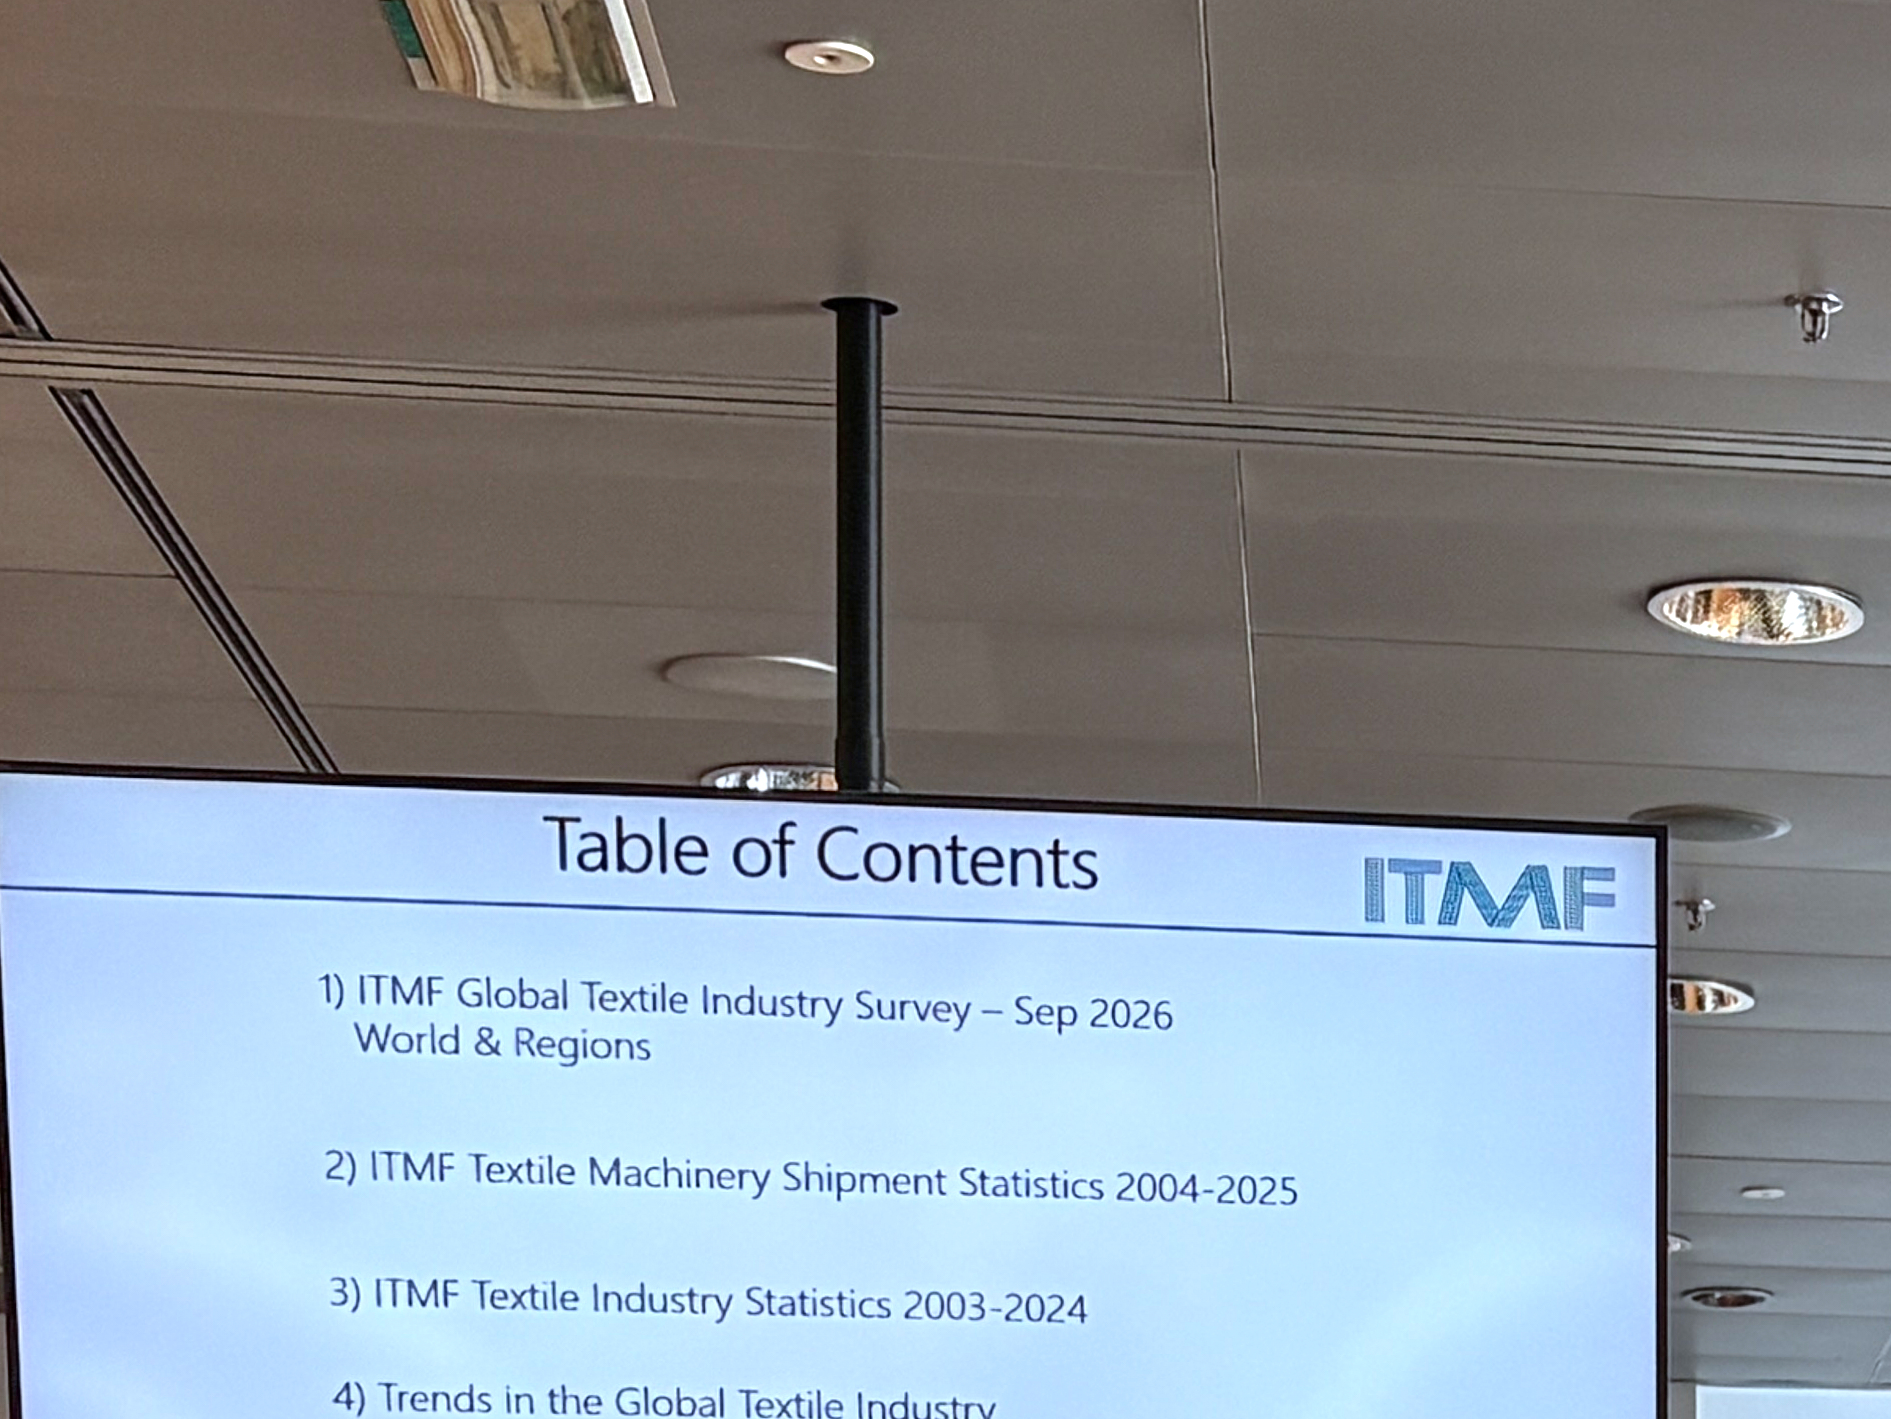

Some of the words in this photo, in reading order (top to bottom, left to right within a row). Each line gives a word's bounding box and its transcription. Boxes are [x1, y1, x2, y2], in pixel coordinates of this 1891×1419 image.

[542, 815, 709, 876] Table
[732, 820, 797, 879] of
[817, 825, 1099, 891] Contents
[1364, 857, 1616, 932] ITMF
[318, 973, 344, 1010] 1)
[359, 974, 444, 1007] ITMF
[457, 975, 568, 1011] Global
[580, 980, 689, 1014] Textile
[702, 984, 844, 1028] Industry
[855, 990, 972, 1032] Survey
[1014, 995, 1078, 1036] Sep
[1089, 998, 1173, 1031] 2026
[353, 1021, 460, 1055] World
[474, 1026, 502, 1057] &
[515, 1026, 651, 1068] Regions
[325, 1149, 357, 1187] 2)
[371, 1150, 455, 1183] ITMF
[468, 1153, 576, 1186] Textile
[589, 1156, 771, 1200] Machinery
[783, 1160, 947, 1202] Shipment
[959, 1166, 1105, 1201] Statistics
[1116, 1171, 1298, 1206] 2004-2025
[330, 1276, 361, 1314] 3)
[375, 1277, 459, 1309] ITMF
[471, 1279, 580, 1311] Textile
[592, 1281, 733, 1325] Industry
[745, 1286, 892, 1319] Statistics
[904, 1290, 1088, 1324] 2003-2024
[332, 1381, 366, 1418] 4)
[377, 1382, 493, 1414] Trends
[505, 1385, 535, 1415] in
[547, 1384, 603, 1416] the
[615, 1385, 725, 1419] Global
